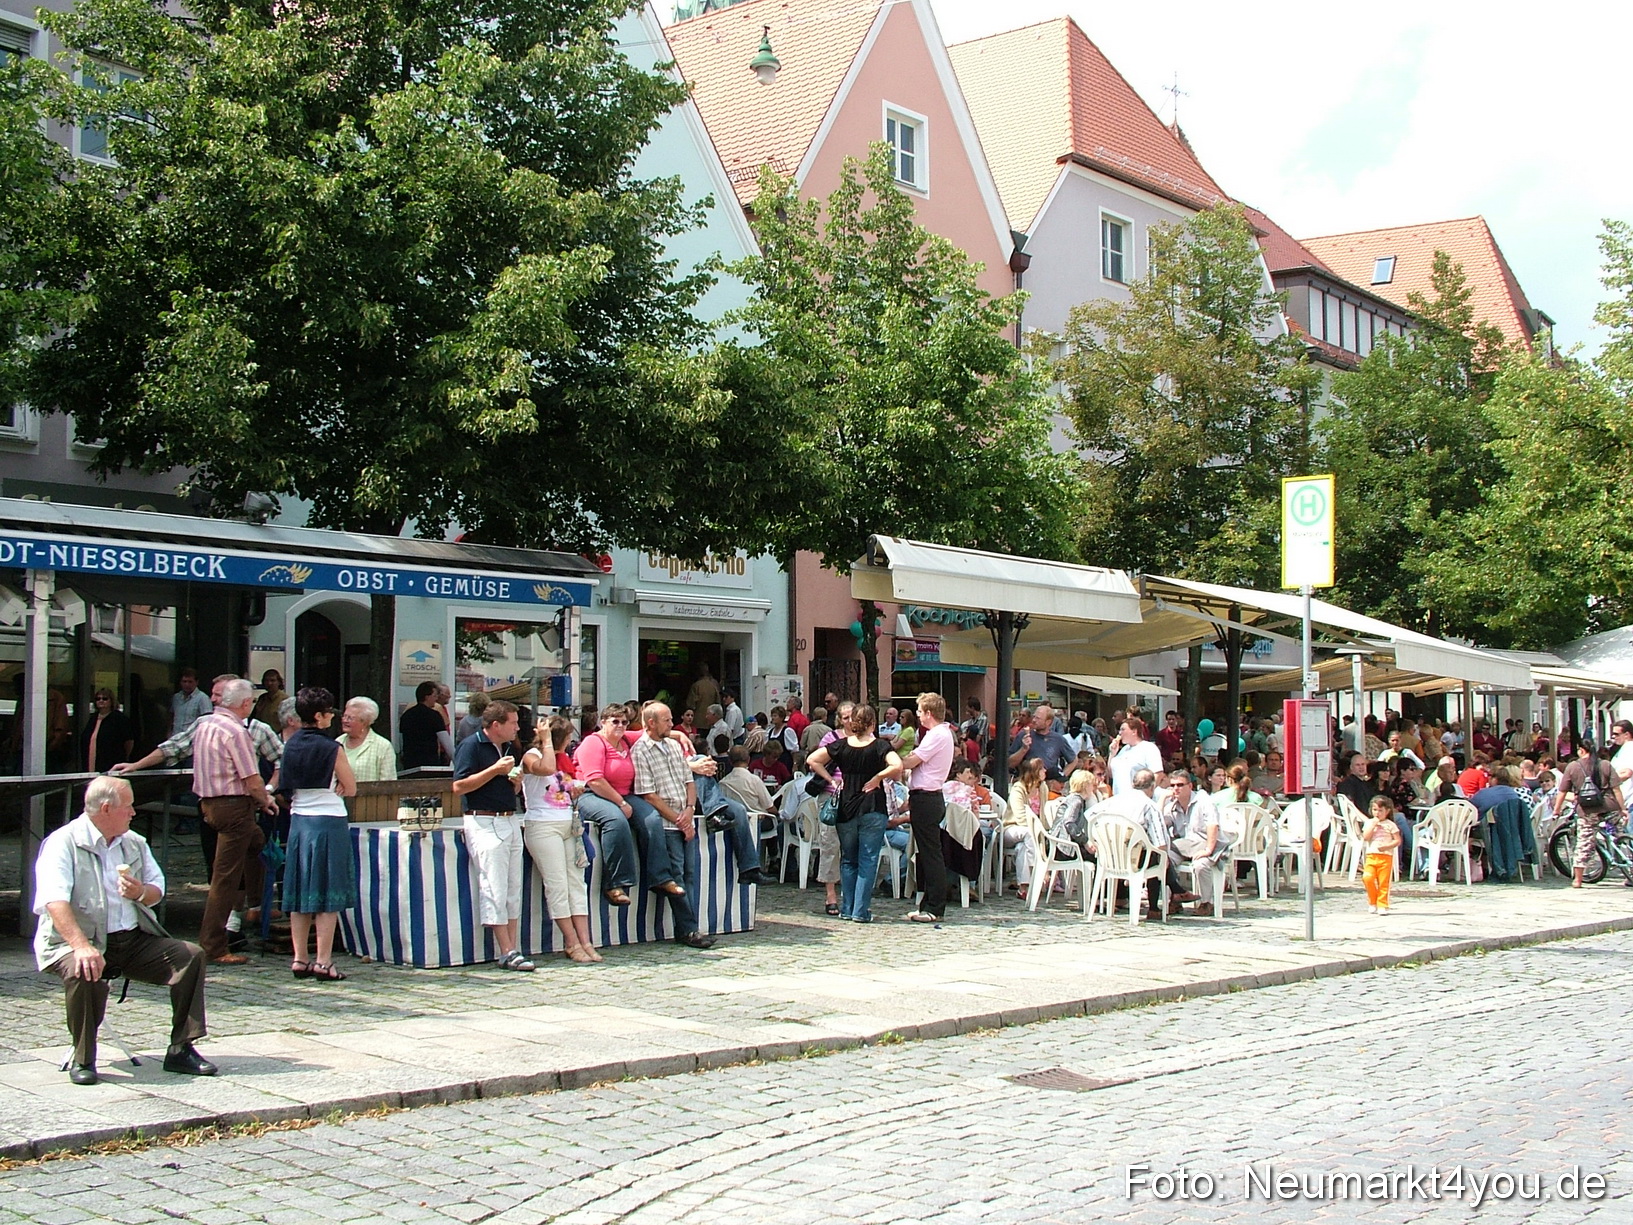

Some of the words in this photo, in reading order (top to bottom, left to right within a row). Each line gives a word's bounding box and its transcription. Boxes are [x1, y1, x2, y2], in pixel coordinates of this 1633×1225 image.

[1300, 494, 1317, 517] H
[338, 569, 399, 591] OBST
[425, 575, 511, 599] GEMÜSE
[796, 639, 807, 651] 20
